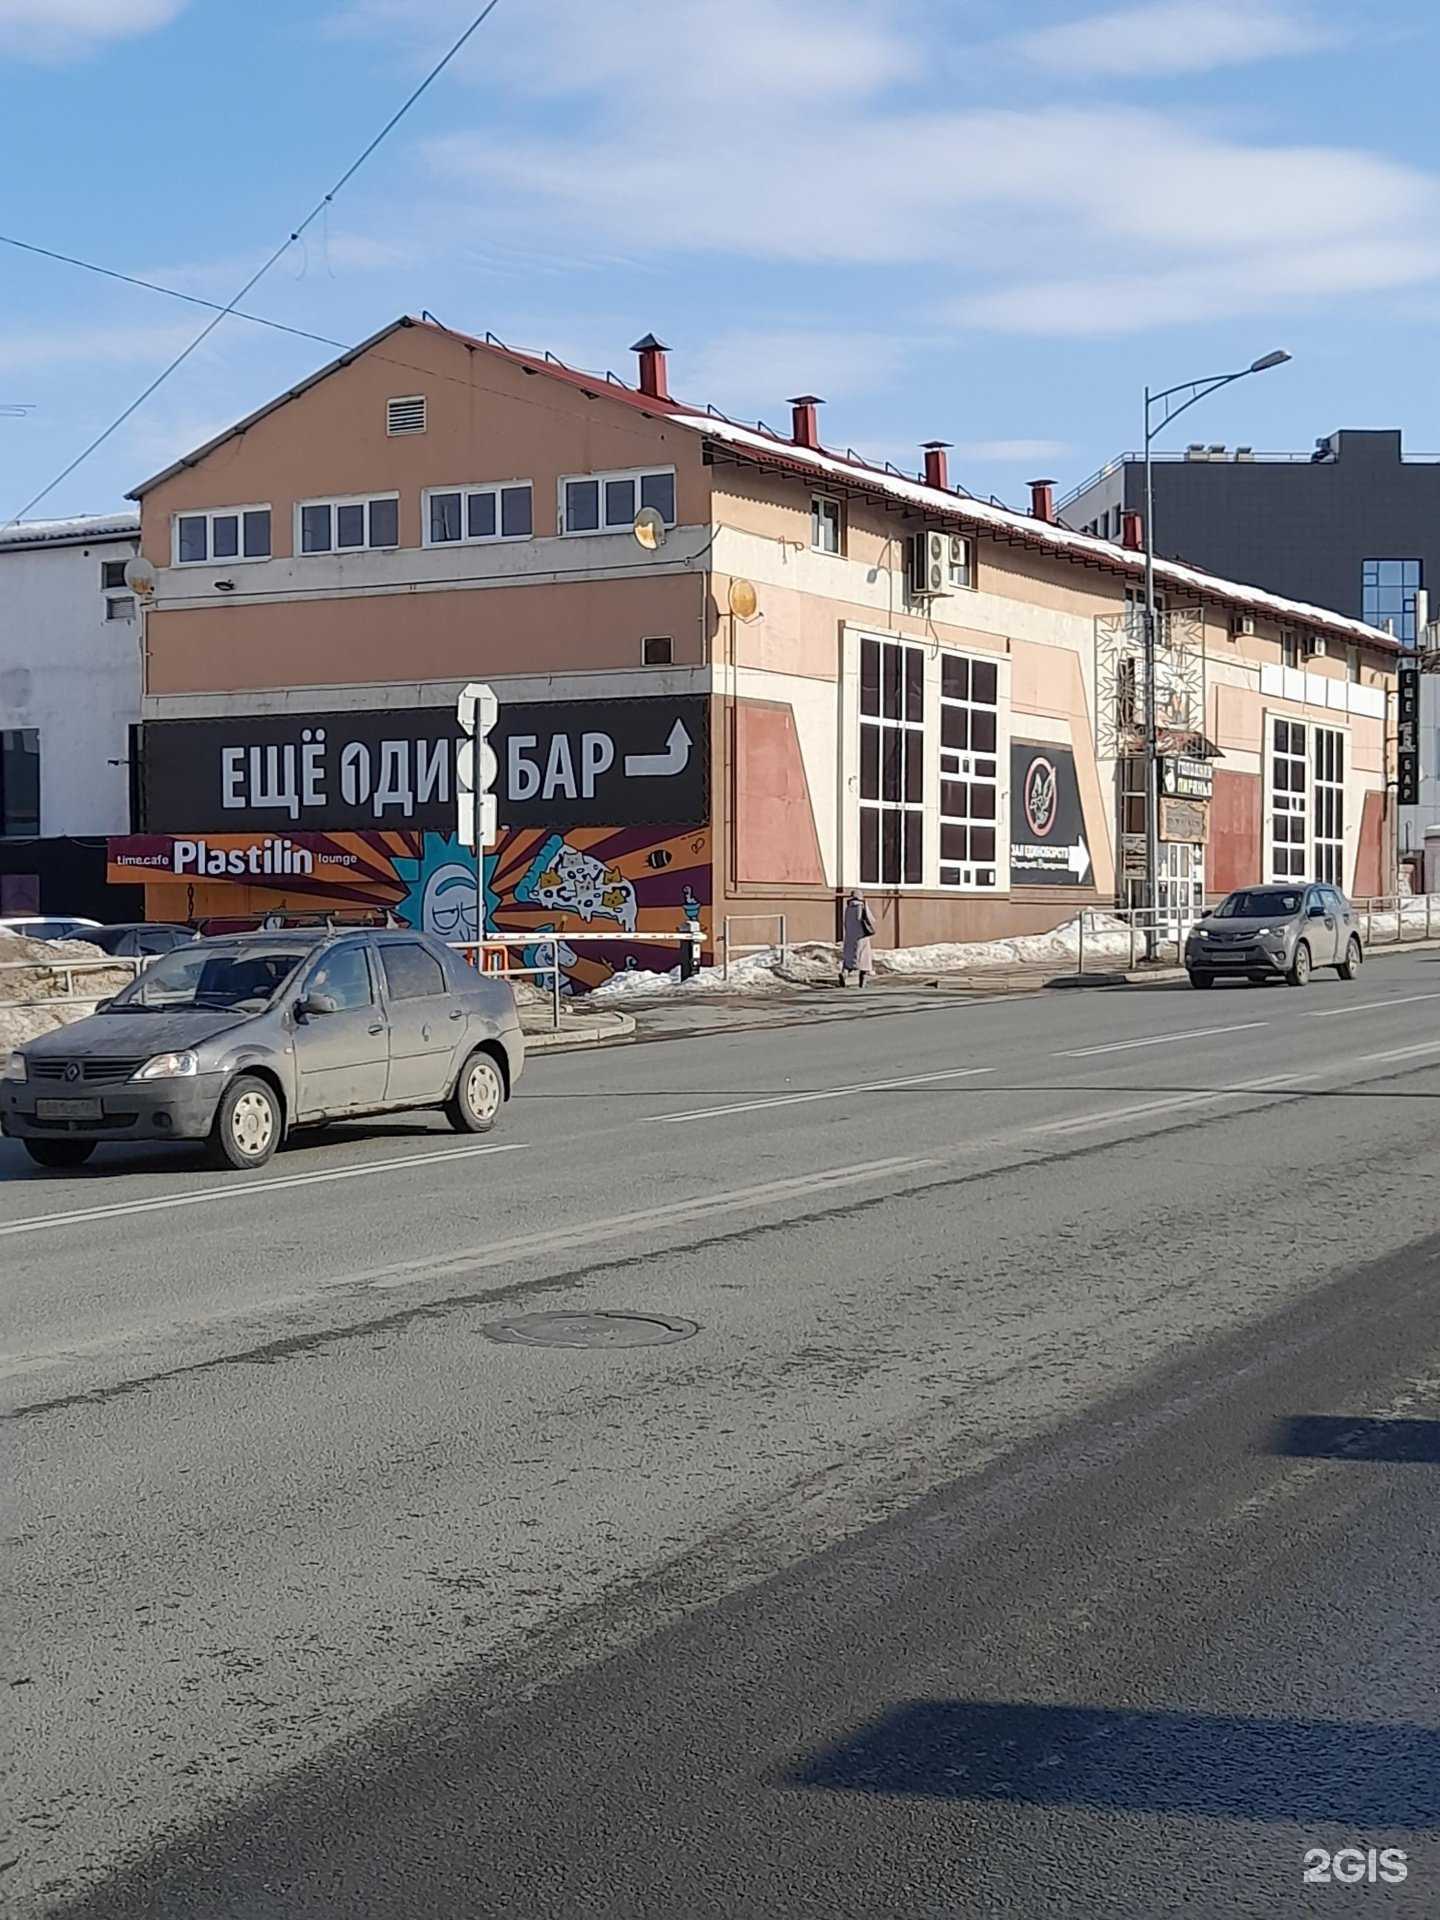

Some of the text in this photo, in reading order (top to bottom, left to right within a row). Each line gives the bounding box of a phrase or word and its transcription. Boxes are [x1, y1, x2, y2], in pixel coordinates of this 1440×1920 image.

[222, 728, 328, 820] ЕЩЁ
[507, 732, 616, 801] БАР
[173, 838, 313, 875] Plastilin
[317, 853, 358, 865] lounge
